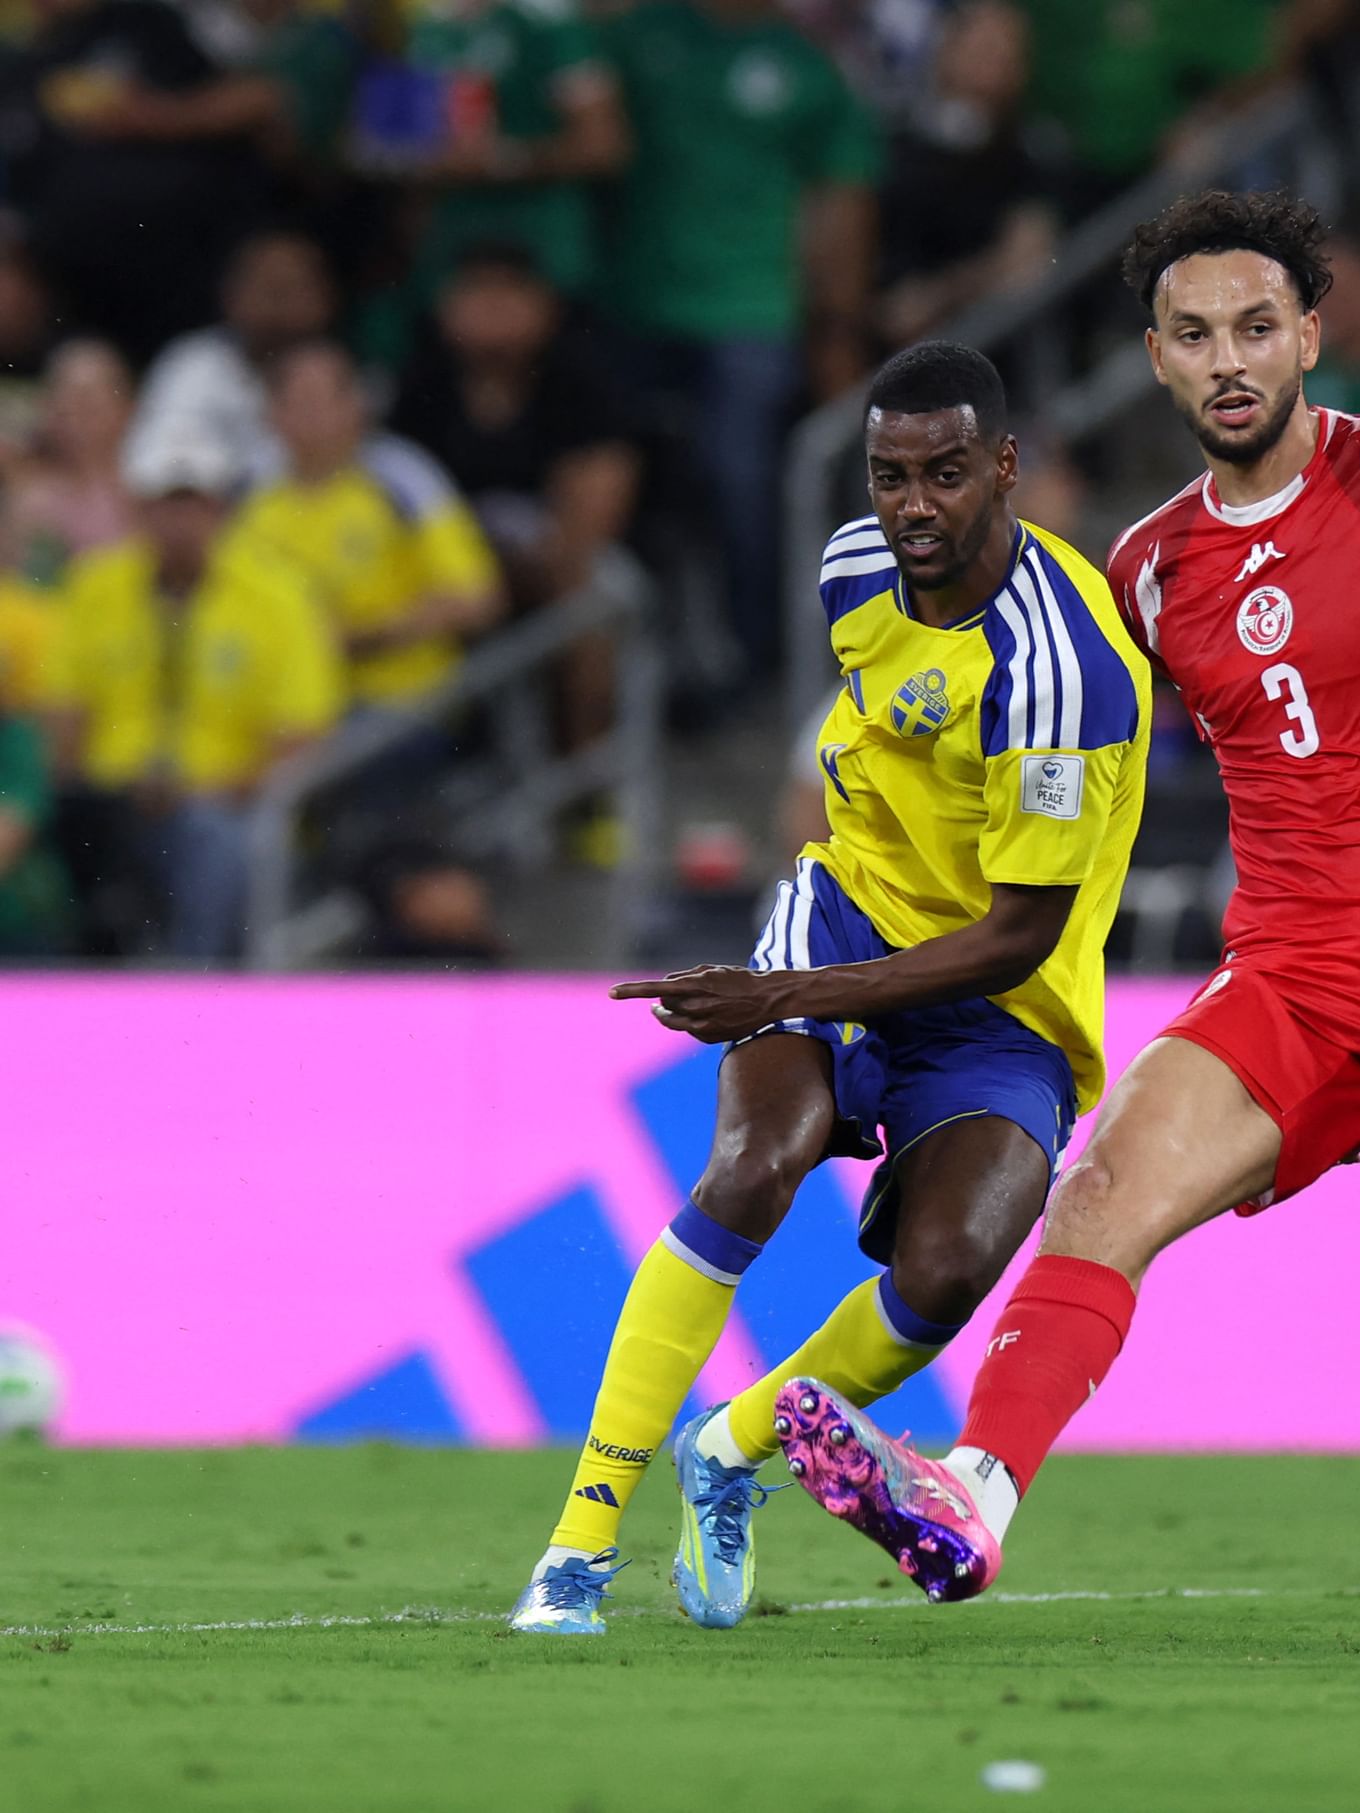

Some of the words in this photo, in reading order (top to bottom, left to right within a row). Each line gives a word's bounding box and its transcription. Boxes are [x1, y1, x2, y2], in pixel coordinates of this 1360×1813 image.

[908, 681, 942, 712] SVERIGE
[1261, 662, 1319, 759] 3
[1037, 790, 1065, 806] PEACE
[1042, 802, 1058, 812] FIFA
[589, 1435, 653, 1464] SVERIGE
